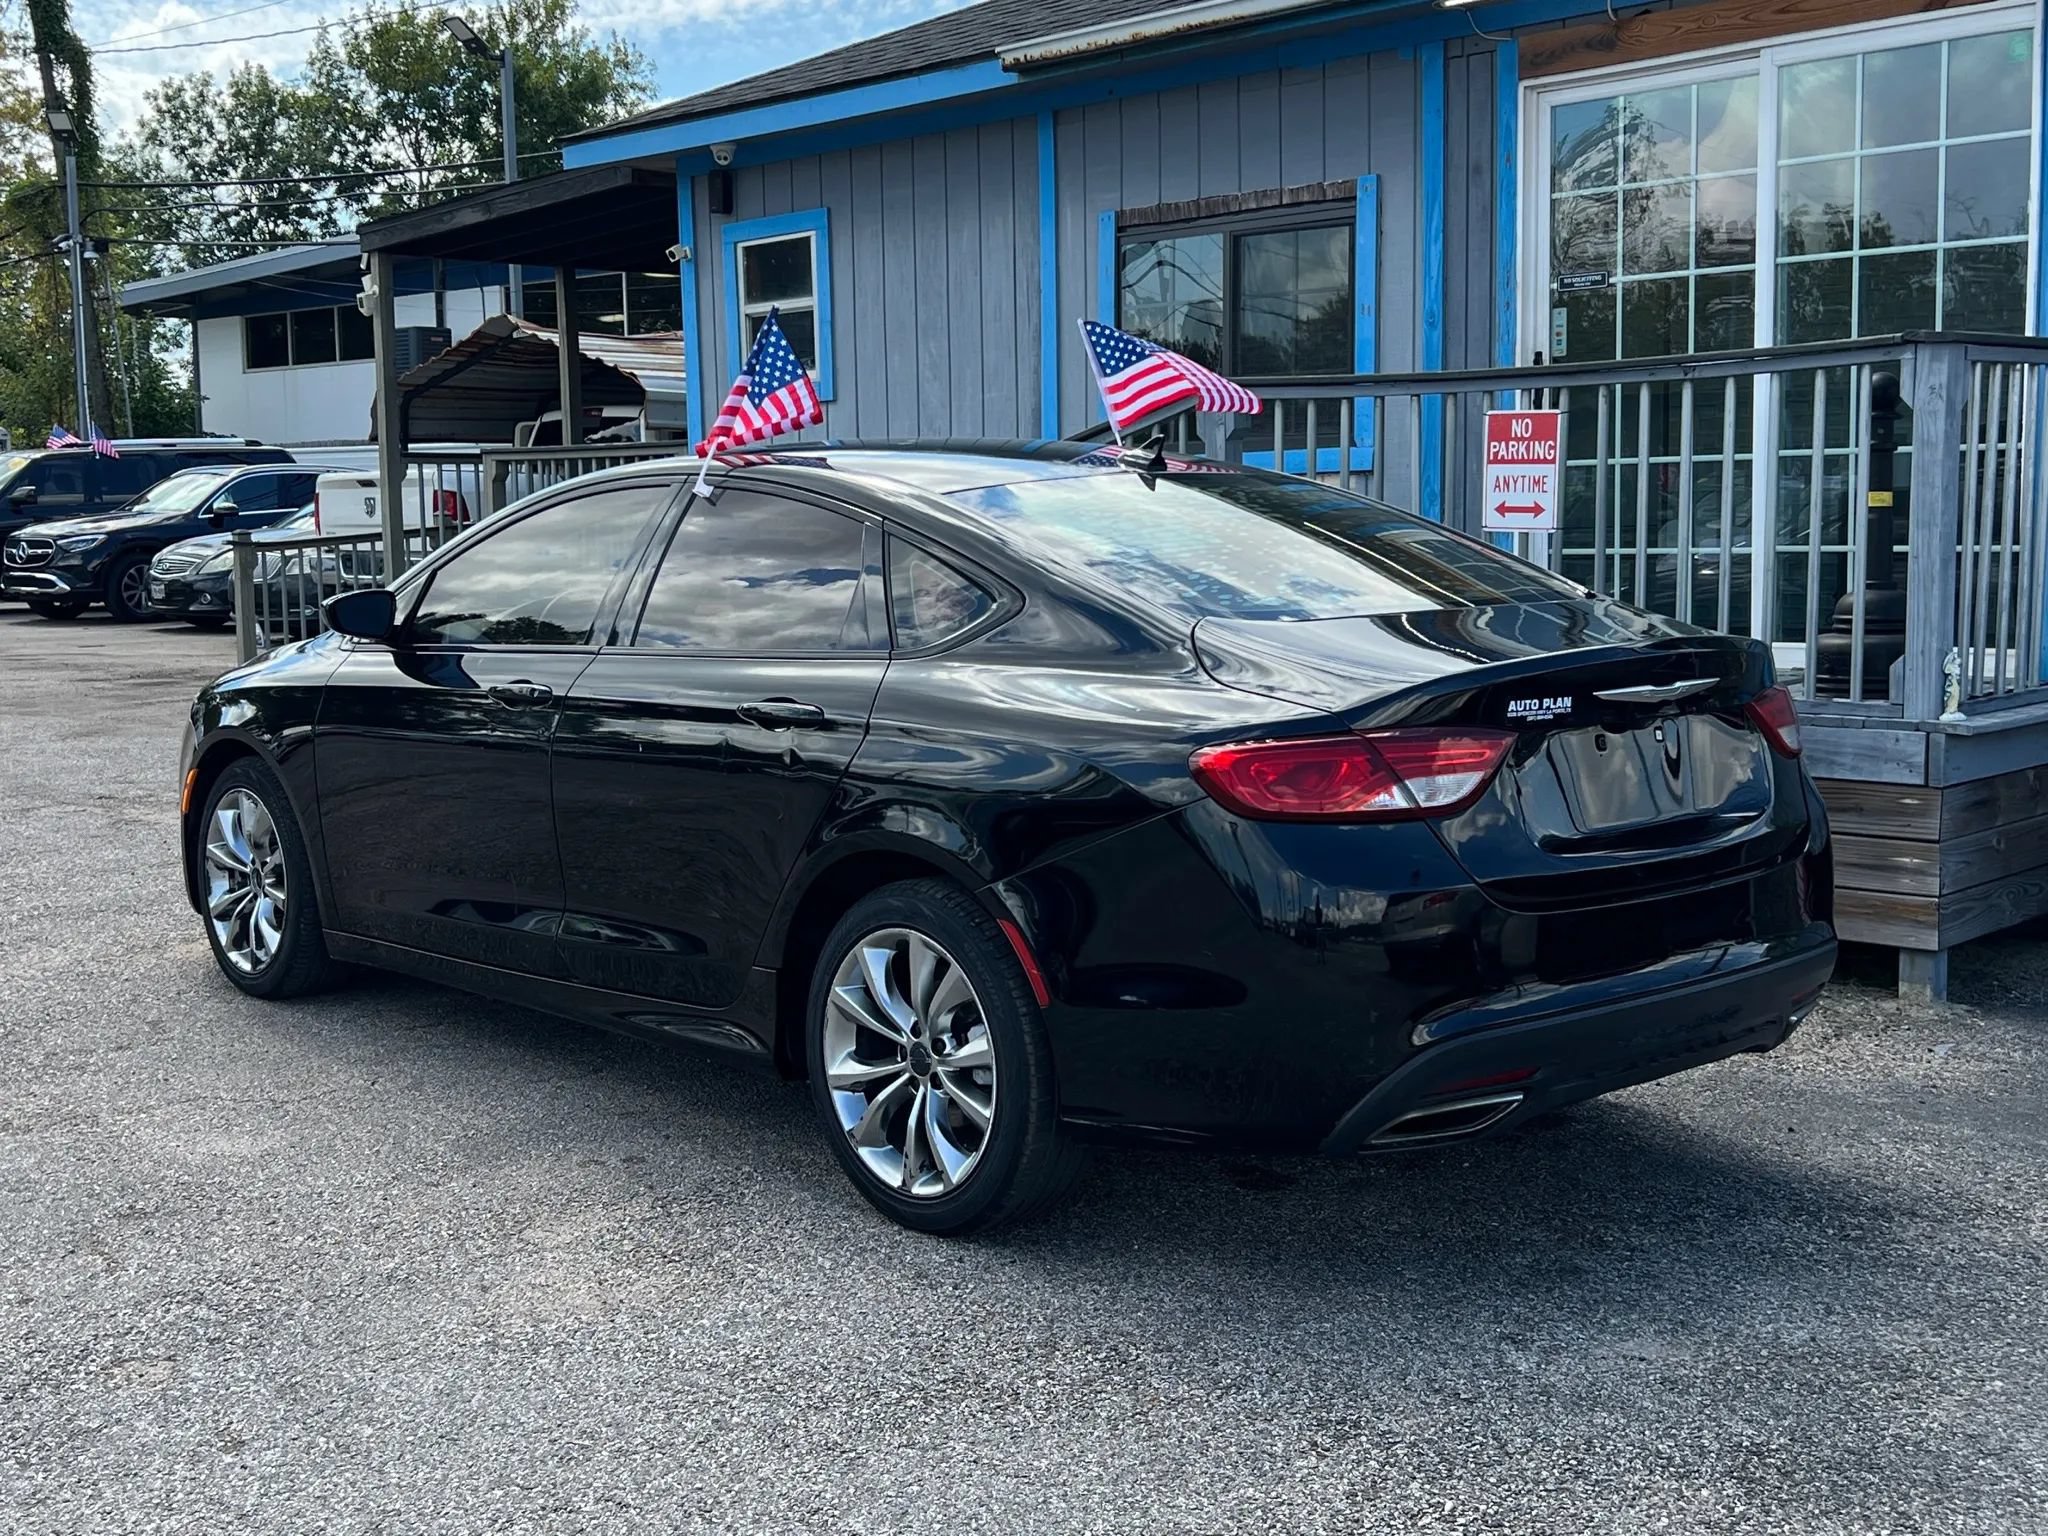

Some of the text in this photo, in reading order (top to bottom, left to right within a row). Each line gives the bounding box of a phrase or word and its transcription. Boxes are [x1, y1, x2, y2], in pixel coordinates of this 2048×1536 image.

[1511, 418, 1532, 438] NO
[1489, 440, 1555, 460] PARKING
[1493, 475, 1549, 493] ANYTIME
[1508, 697, 1572, 711] AUTO PLAN
